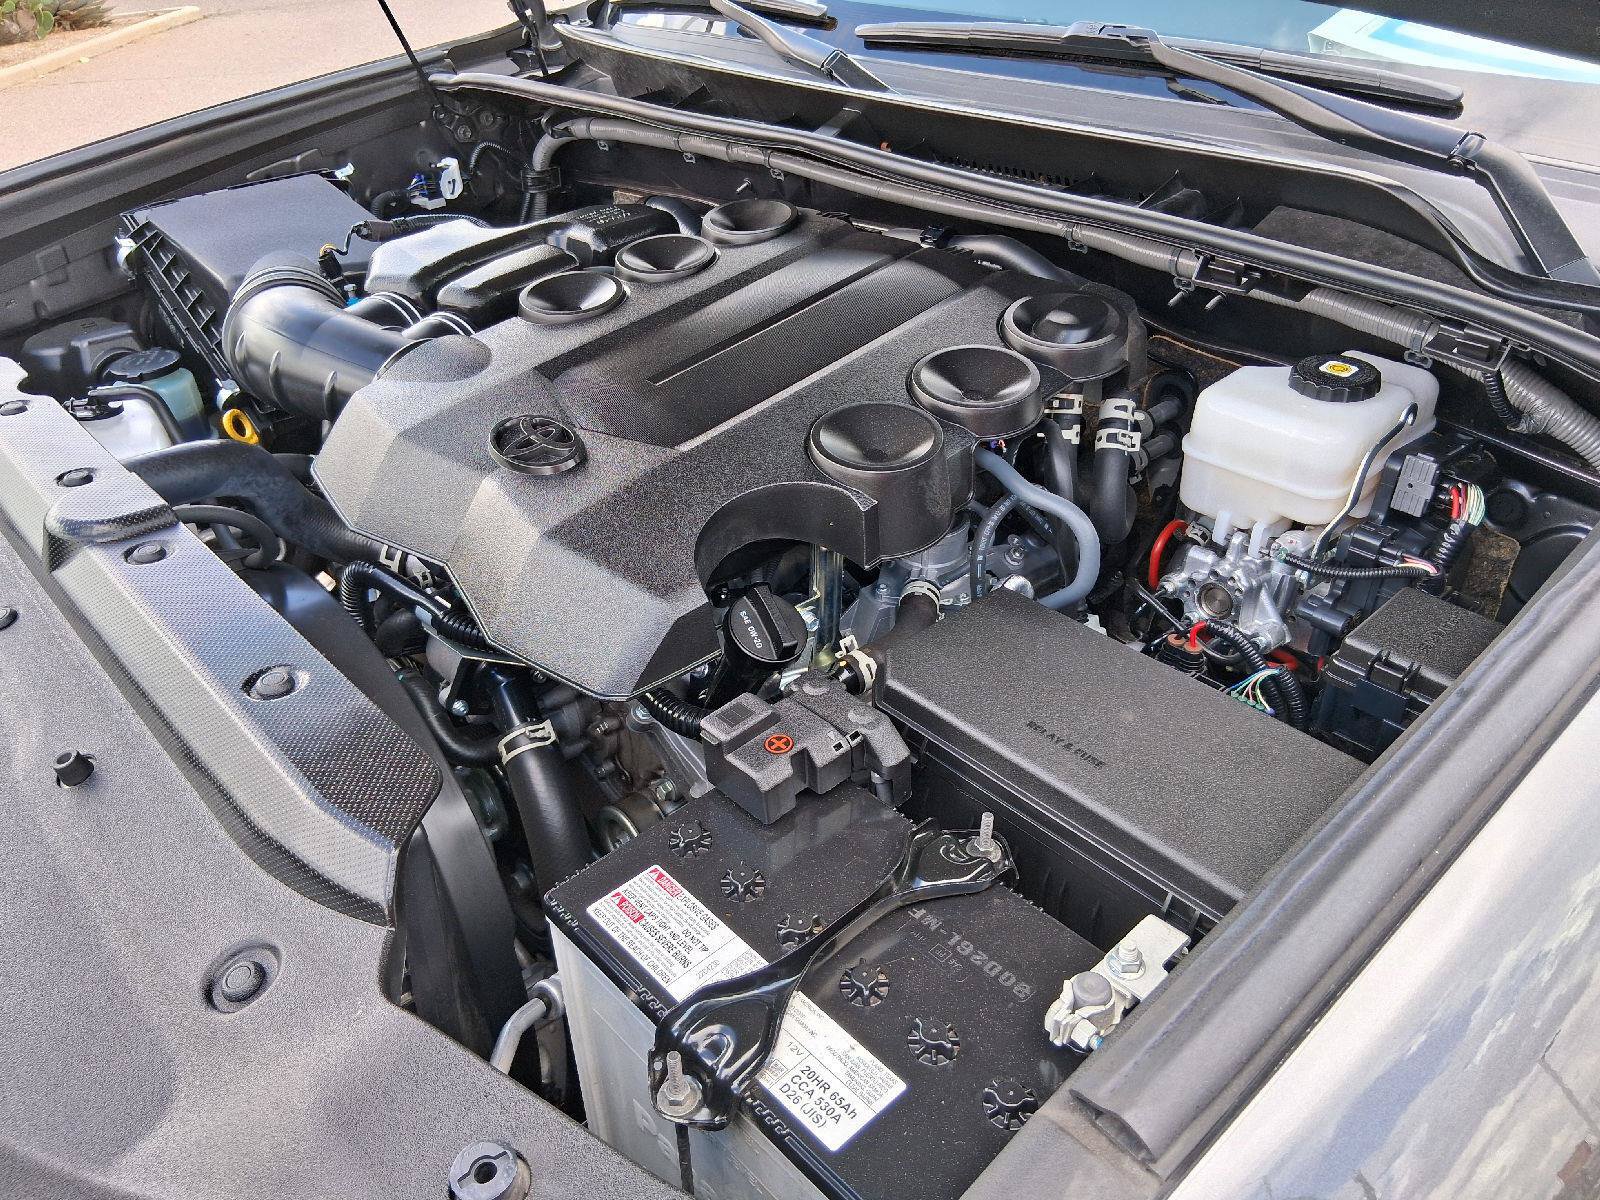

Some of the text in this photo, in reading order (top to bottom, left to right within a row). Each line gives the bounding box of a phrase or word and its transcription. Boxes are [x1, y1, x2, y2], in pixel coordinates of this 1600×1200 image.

[740, 610, 763, 649] SAE 0W-20
[593, 907, 673, 984] KEEP OUT OF THE REACH OF CHILDREN
[623, 887, 637, 901] KEEP
[644, 908, 659, 921] CAPS
[656, 918, 671, 932] TIGHT
[677, 938, 694, 954] LEVEL
[639, 918, 660, 937] CAUSES
[655, 933, 677, 953] SEVERE
[672, 949, 693, 968] BURNS
[690, 935, 702, 947] NOT
[786, 1041, 804, 1057] 12V
[779, 1082, 827, 1129] D26 (JIS)
[790, 1073, 815, 1099] CCA
[814, 1095, 842, 1124] 530A
[800, 1064, 830, 1094] 20HR
[829, 1090, 858, 1119] 65Ah
